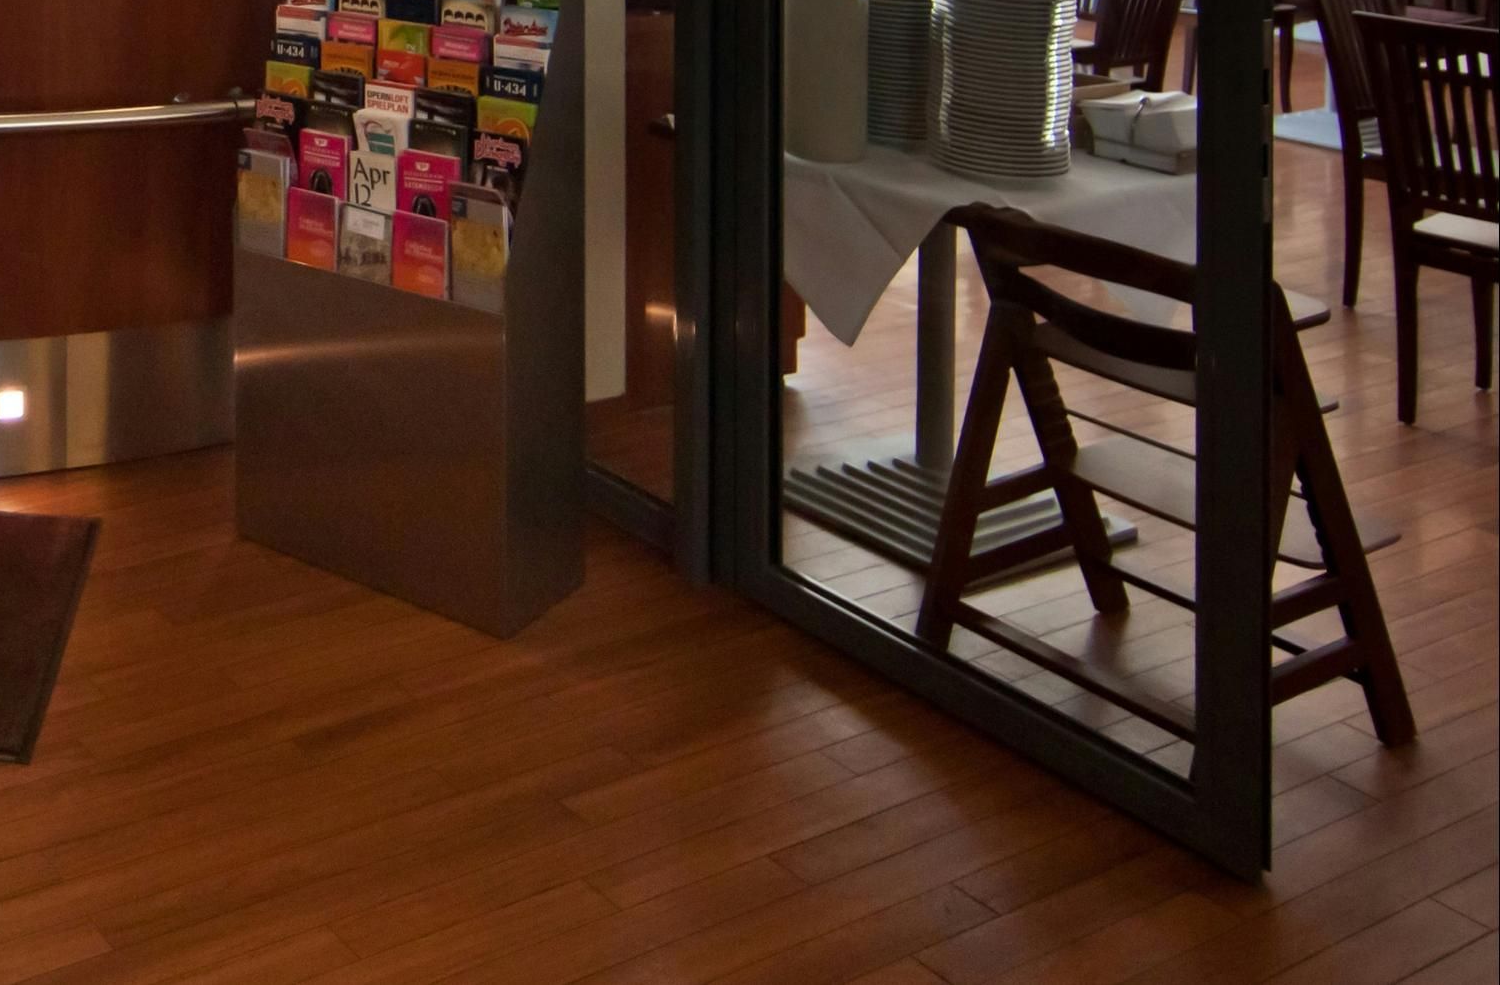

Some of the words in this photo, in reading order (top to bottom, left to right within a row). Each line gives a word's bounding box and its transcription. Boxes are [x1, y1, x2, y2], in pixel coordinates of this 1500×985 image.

[493, 79, 526, 97] U-434
[366, 99, 409, 113] SPIELPLAN
[353, 157, 391, 190] Apr
[355, 182, 372, 207] 12
